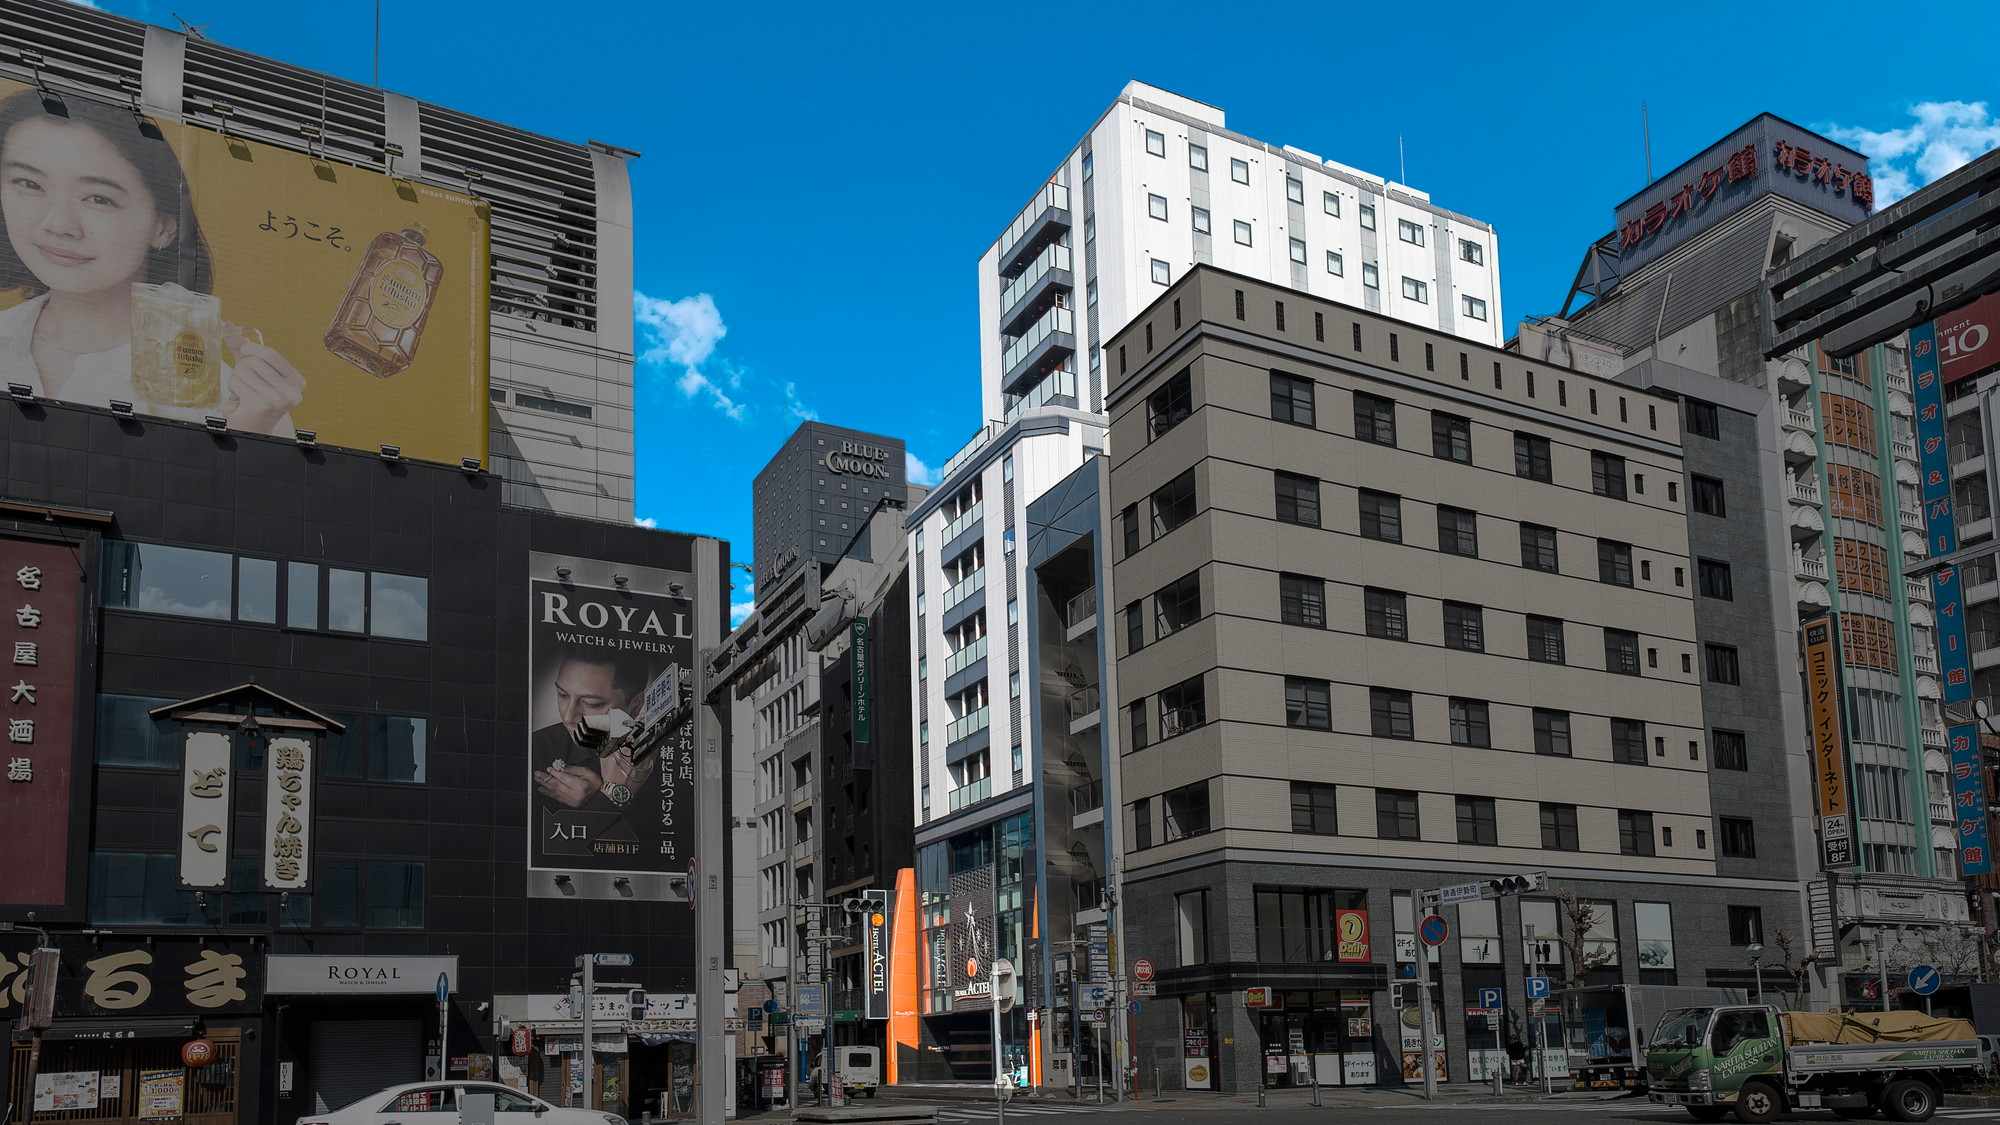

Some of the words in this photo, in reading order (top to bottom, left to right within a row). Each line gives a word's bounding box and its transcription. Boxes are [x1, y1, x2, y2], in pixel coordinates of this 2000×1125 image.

[1775, 139, 1874, 205] カラオケ館
[1620, 143, 1758, 250] カラオケ館
[259, 210, 352, 252] ようこそ。
[841, 440, 885, 461] BLUE
[835, 457, 886, 479] MOON
[541, 591, 693, 640] ROYAL
[556, 631, 605, 647] WATCH
[607, 638, 617, 648] &
[617, 638, 676, 655] JEWELRY
[7, 565, 43, 783] 名古屋大酒場
[856, 637, 866, 721] 名古屋栄グリーンホテル
[188, 767, 227, 853] どて
[1952, 734, 1983, 865] カラオケ館
[273, 746, 306, 882] 鶏ちゃん焼き
[1827, 819, 1844, 830] 24h
[549, 822, 588, 840] 入口
[1827, 828, 1845, 836] OPEN
[593, 842, 640, 855] 店舗B1F
[1828, 840, 1848, 852] 受付
[1831, 852, 1846, 862] 8F
[1340, 942, 1368, 958] Daily
[328, 966, 402, 979] ROYAL
[1532, 979, 1545, 996] P
[1484, 990, 1498, 1008] P
[752, 1009, 761, 1020] P
[1713, 1054, 1745, 1073] NARITA
[1743, 1037, 1778, 1060] SHUHAN
[1350, 1070, 1370, 1079] あります
[1721, 1055, 1759, 1079] EXPRESS
